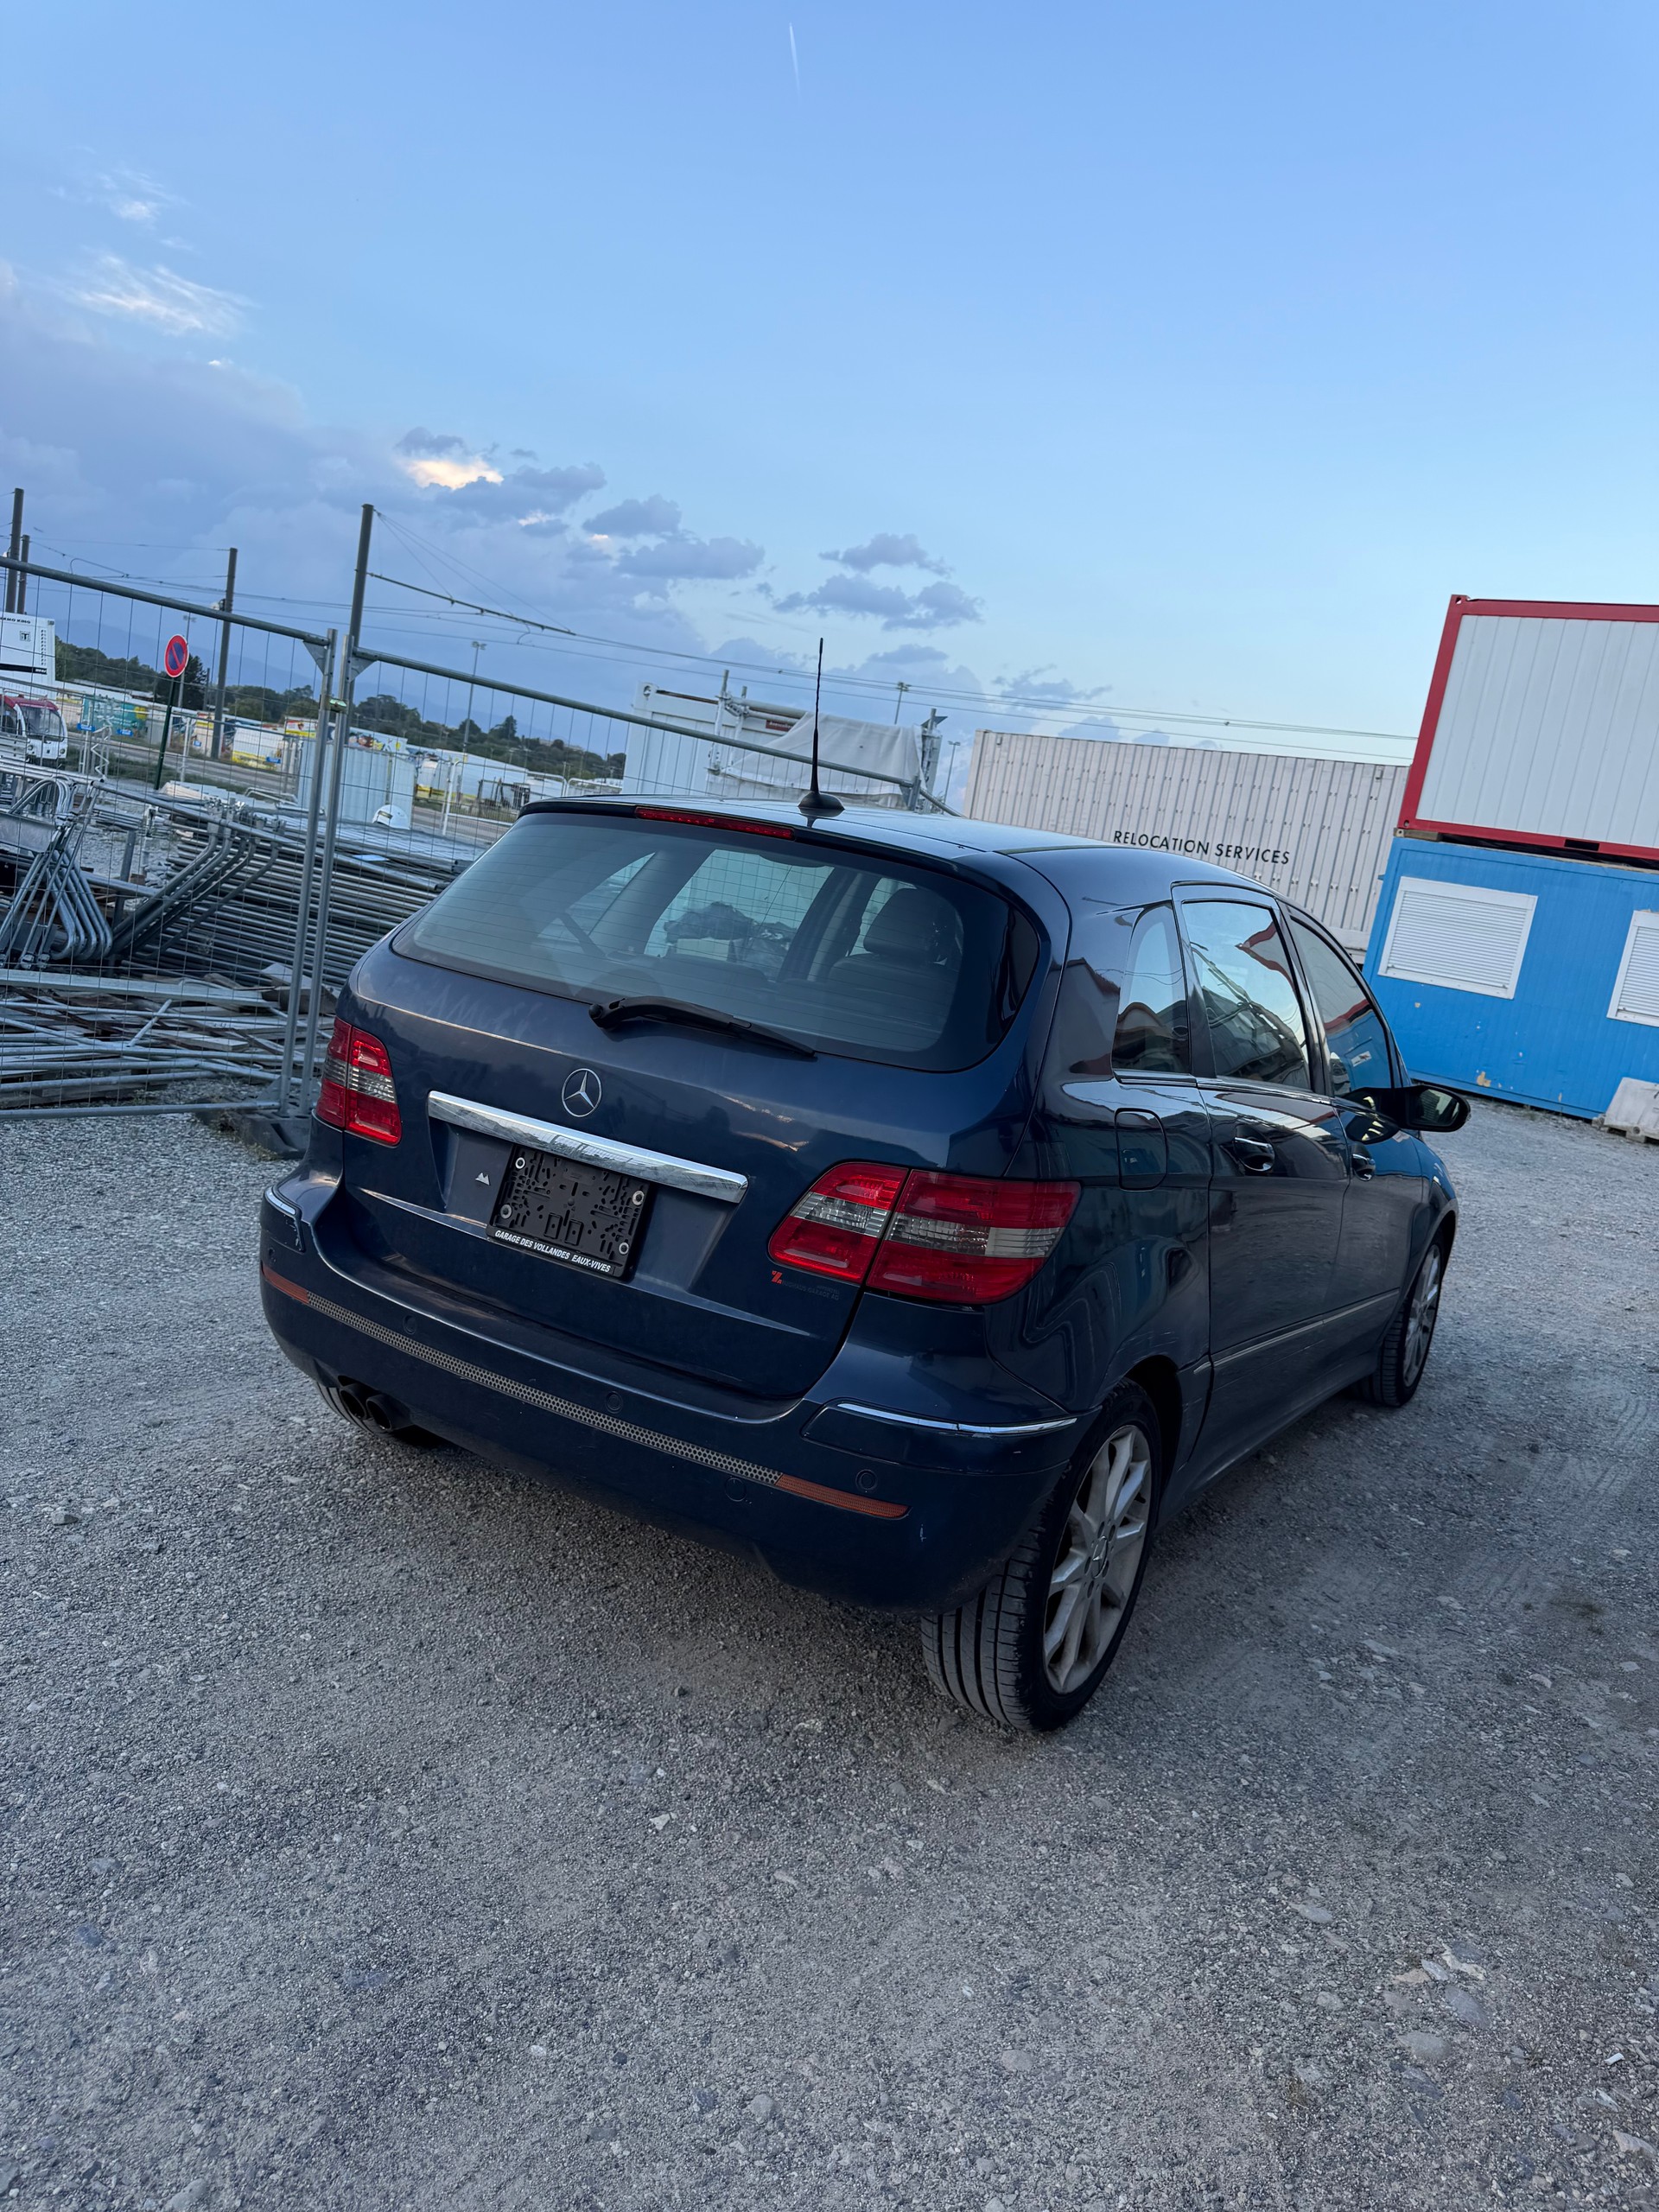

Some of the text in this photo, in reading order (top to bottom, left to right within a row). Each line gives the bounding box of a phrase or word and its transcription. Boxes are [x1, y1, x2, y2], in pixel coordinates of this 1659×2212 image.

[1113, 830, 1290, 865] RELOCATION SERVICES
[495, 1230, 611, 1273] GARAGE DES VOLLANDES EAUX-VIVES
